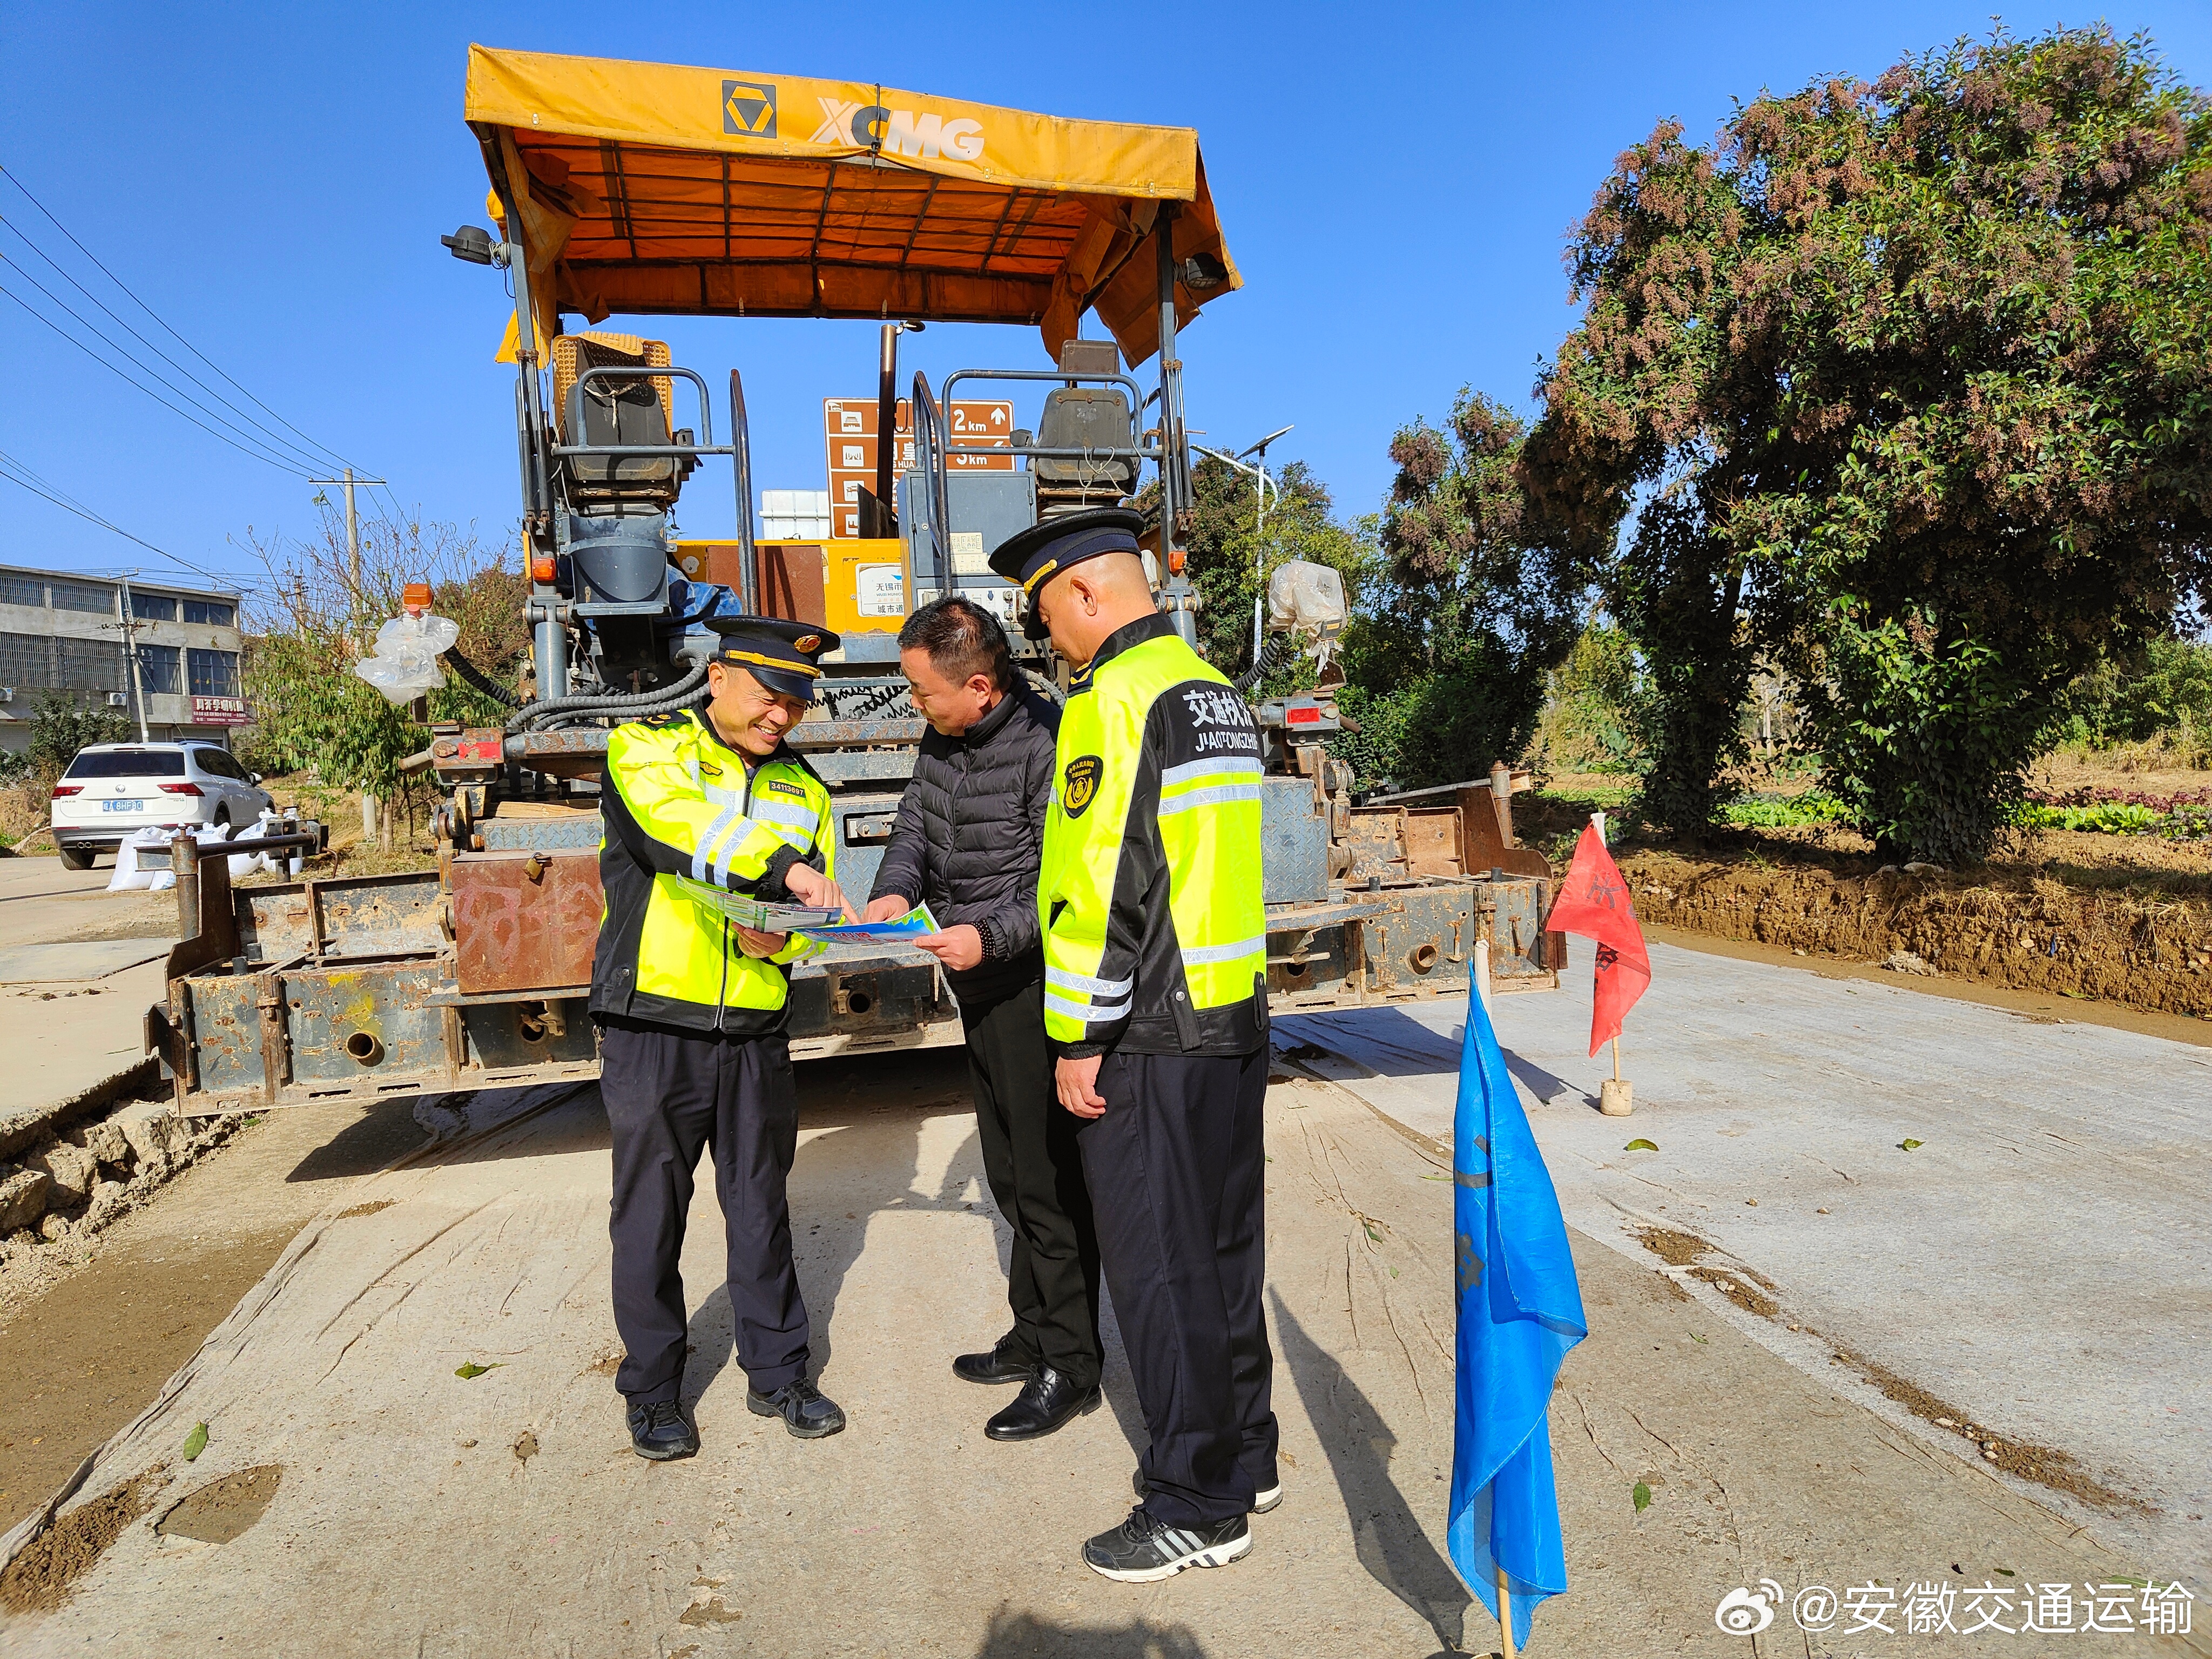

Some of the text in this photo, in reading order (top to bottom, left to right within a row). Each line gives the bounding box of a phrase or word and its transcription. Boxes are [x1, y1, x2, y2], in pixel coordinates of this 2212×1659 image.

[808, 97, 984, 160] XCMG
[953, 409, 966, 431] 2
[968, 420, 987, 431] km
[968, 455, 987, 465] km
[876, 583, 902, 591] 无锡市
[878, 604, 904, 613] 城市道
